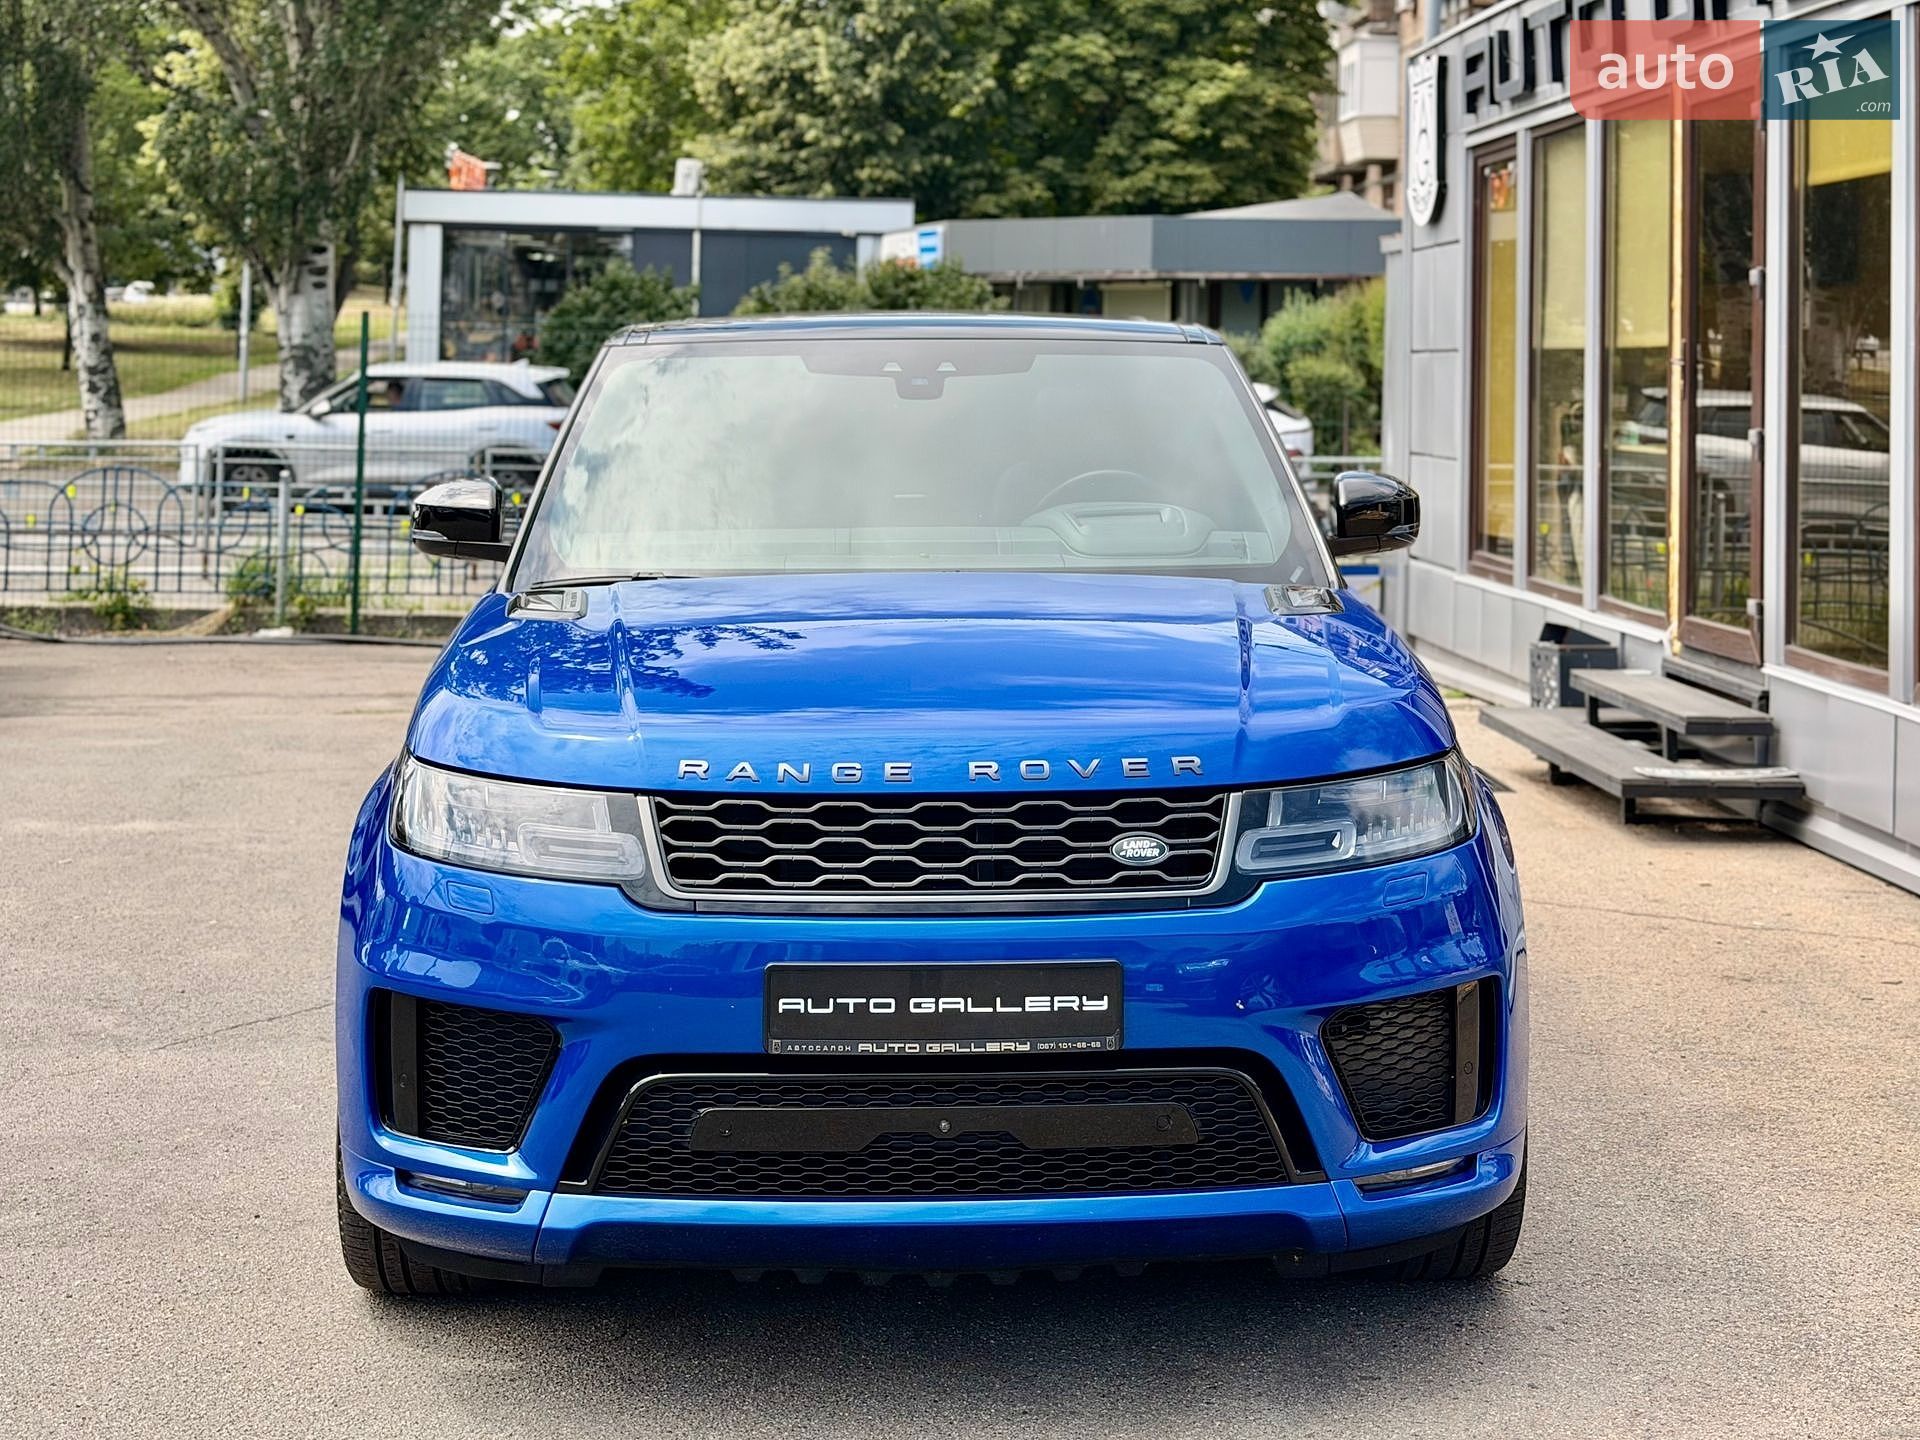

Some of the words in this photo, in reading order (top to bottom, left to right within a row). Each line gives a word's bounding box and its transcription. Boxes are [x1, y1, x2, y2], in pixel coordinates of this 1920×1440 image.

[677, 759, 913, 783] RANGE
[968, 755, 1204, 781] ROVER
[1123, 840, 1150, 848] LAND
[1126, 848, 1160, 857] ROVER
[778, 997, 896, 1014] AUTO
[909, 995, 1109, 1014] GALLERY
[858, 1043, 919, 1053] AUTO
[925, 1041, 1031, 1053] GALLERY
